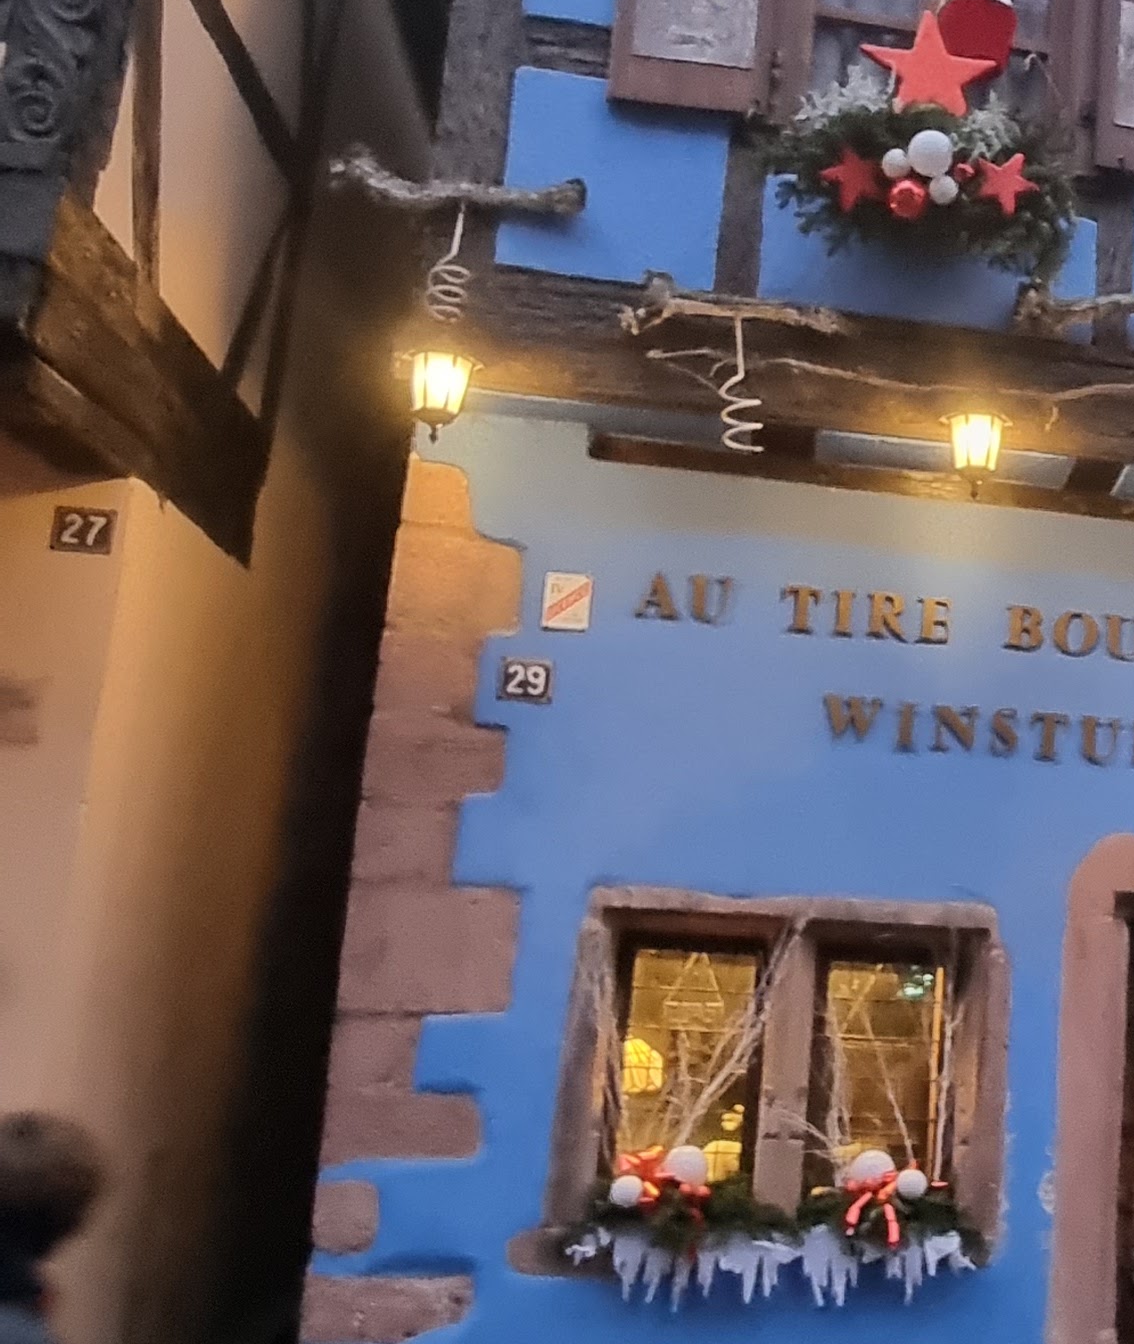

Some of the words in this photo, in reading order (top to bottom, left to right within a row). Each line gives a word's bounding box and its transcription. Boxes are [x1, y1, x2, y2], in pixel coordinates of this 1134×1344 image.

[60, 513, 107, 546] 27
[636, 572, 734, 624] AU
[779, 583, 951, 643] TIRE
[506, 664, 546, 695] 29
